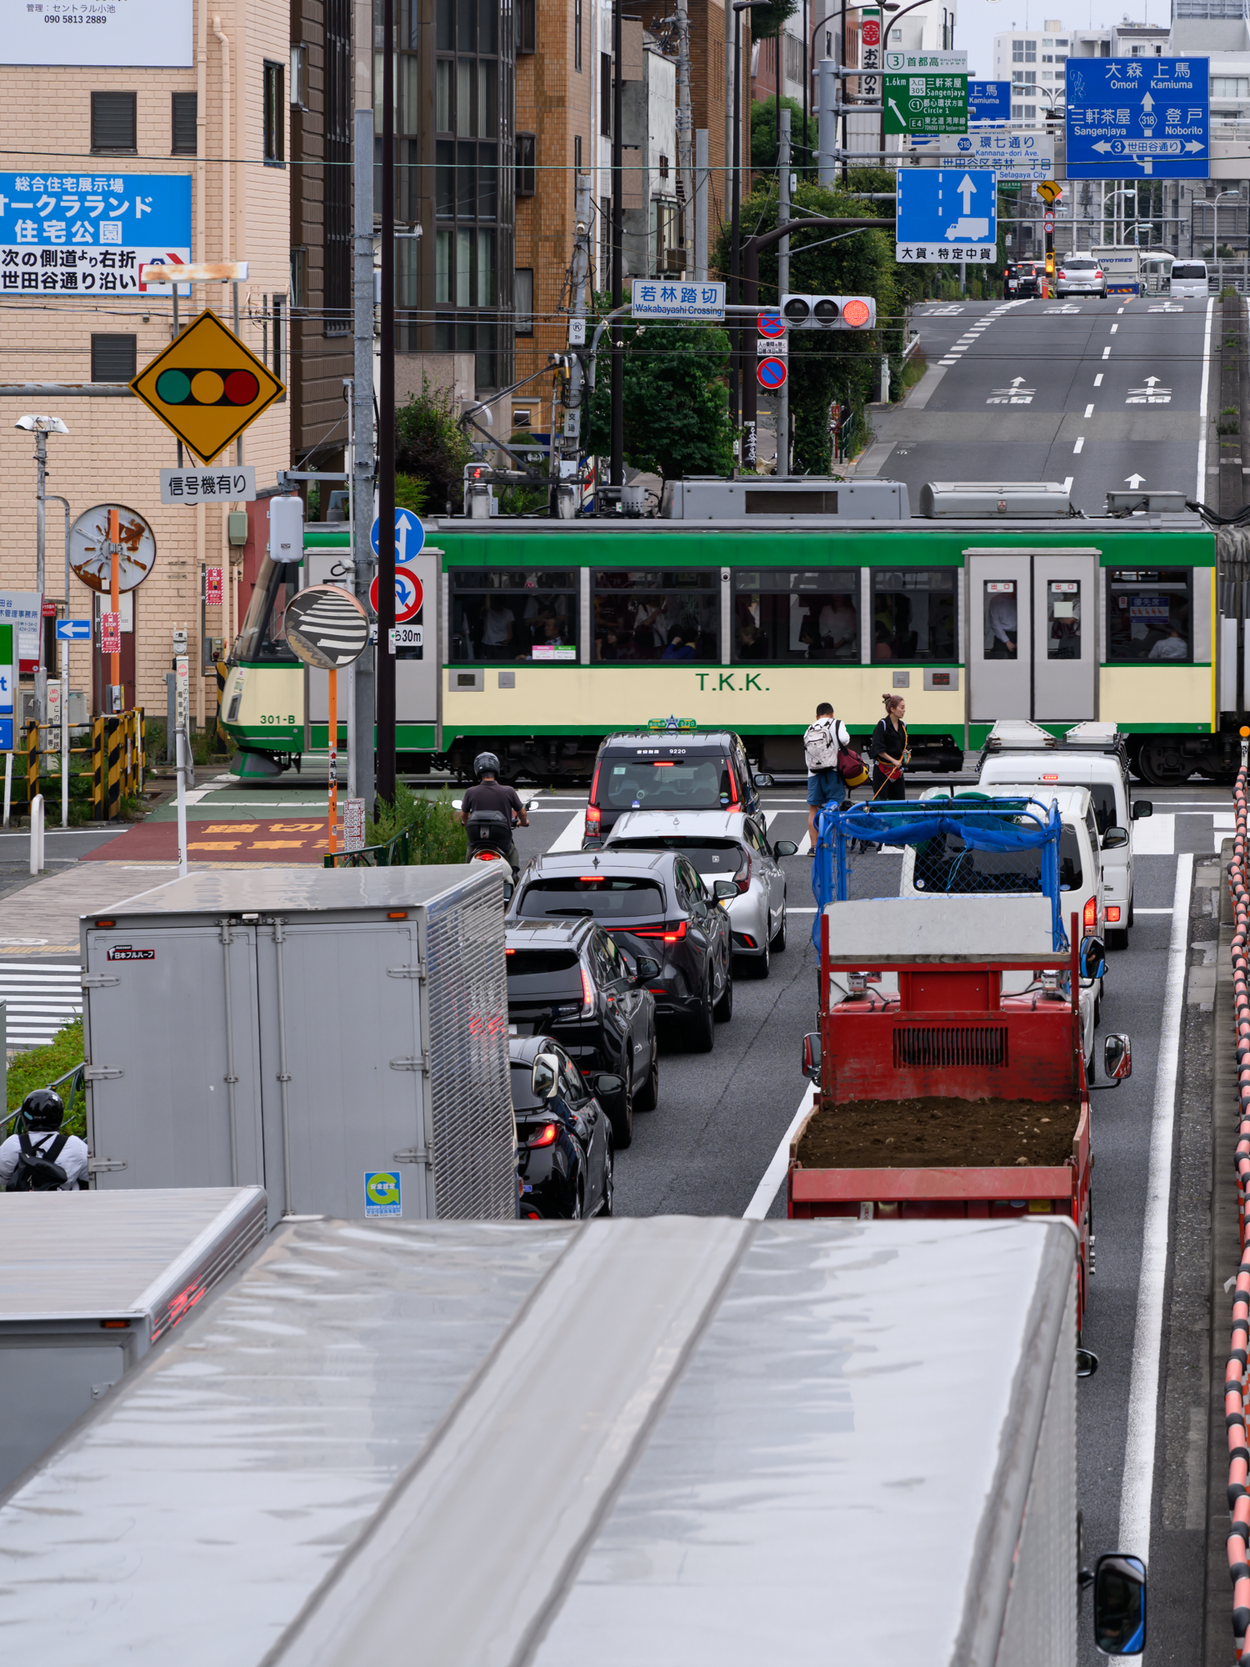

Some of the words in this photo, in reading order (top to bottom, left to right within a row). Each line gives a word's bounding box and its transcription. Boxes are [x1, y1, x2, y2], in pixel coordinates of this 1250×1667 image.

[44, 15, 60, 24] 090
[62, 15, 83, 24] 5813
[86, 15, 107, 24] 2889
[892, 56, 899, 66] 3
[907, 57, 939, 67] 首都高
[1105, 62, 1143, 78] 大森
[1153, 62, 1190, 78] 上馬
[886, 77, 907, 86] 1.6km
[927, 78, 962, 88] 三軒茶屋
[1110, 80, 1138, 89] Omori
[1151, 80, 1193, 89] Kamiuma
[926, 88, 965, 98] Sangenjaya
[971, 84, 998, 96] 上馬
[1070, 108, 1131, 124] 三軒茶屋
[1141, 115, 1155, 125] 318
[1165, 108, 1203, 124] 登戸
[1074, 126, 1127, 137] Sangenjaya
[1165, 126, 1203, 135] Noborito
[958, 140, 971, 149] 318
[980, 136, 1035, 149] 環七通り
[1114, 142, 1122, 152] 3
[1127, 141, 1179, 152] 世田谷通り
[1000, 171, 1031, 180] Setagaya
[1033, 171, 1047, 180] City
[15, 176, 124, 193] 総合住宅展示場
[14, 219, 123, 244] 住宅公園
[1, 249, 137, 269] 次の側道より右折
[901, 247, 991, 260] 大貨・特定中貨
[1, 271, 137, 290] 世田谷通り沿い
[640, 285, 718, 304] 若林踏切
[635, 303, 687, 315] Wakabayashi
[688, 305, 722, 316] Crossing
[168, 474, 247, 496] 信号機有り
[695, 673, 770, 691] T.K.K.
[260, 715, 296, 724] 301-B
[114, 951, 154, 959] 日本フルハーフ
